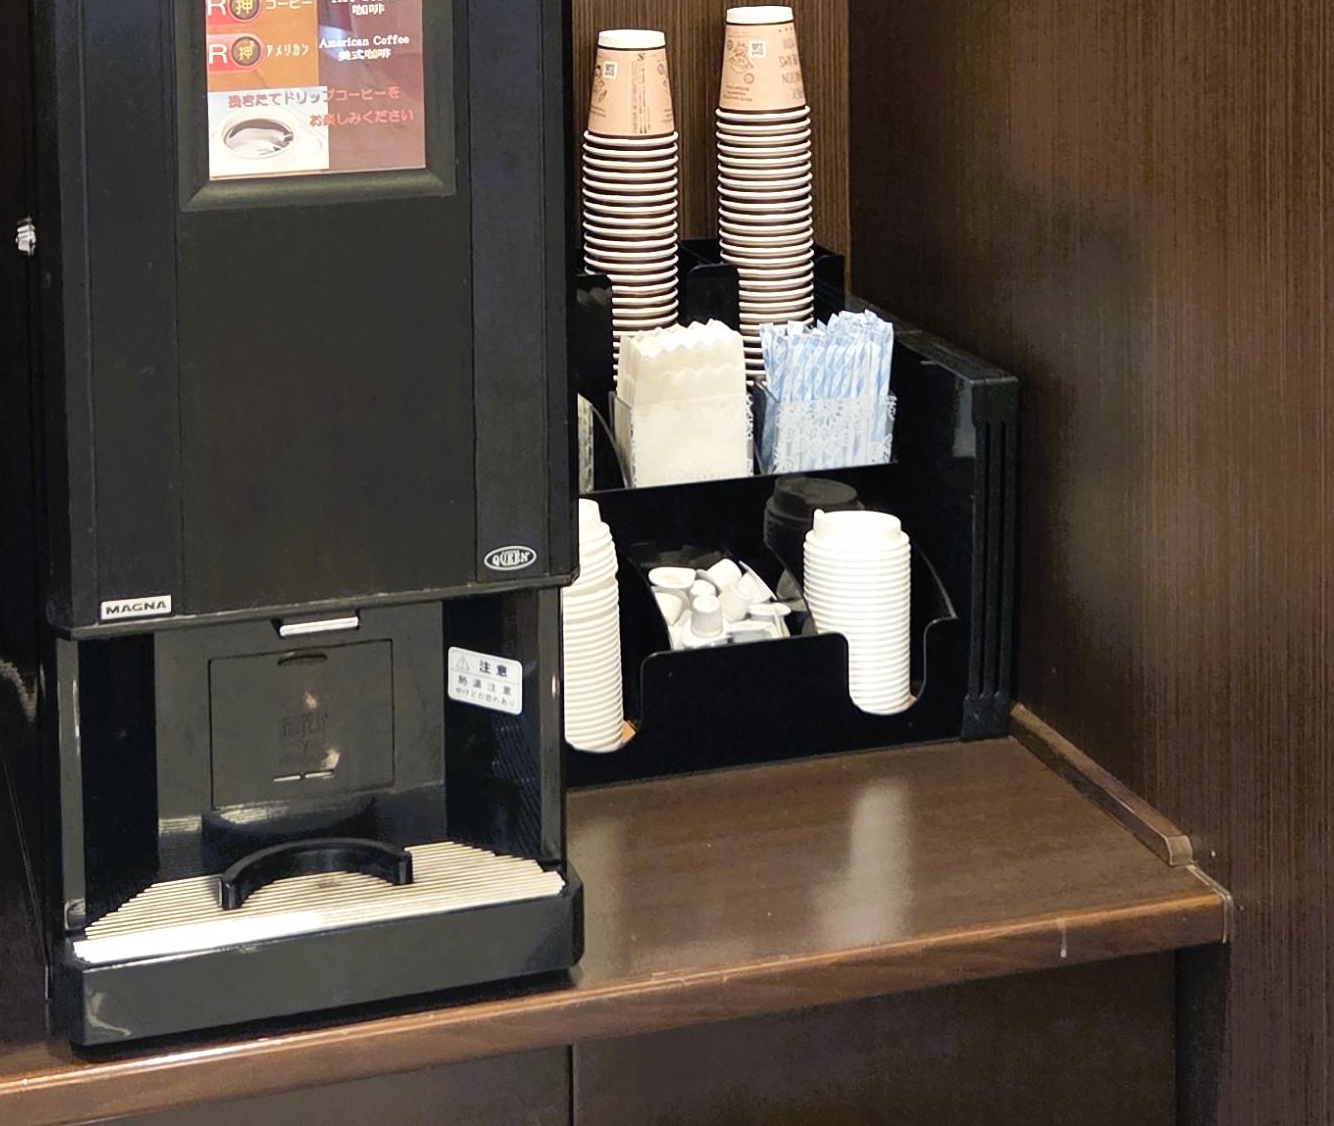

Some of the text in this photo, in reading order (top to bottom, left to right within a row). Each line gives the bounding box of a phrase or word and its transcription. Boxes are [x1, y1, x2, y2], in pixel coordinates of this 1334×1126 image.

[319, 34, 409, 48] American Coffee
[208, 44, 227, 64] R
[266, 44, 309, 58] アメリカン
[105, 600, 167, 615] MAGNA
